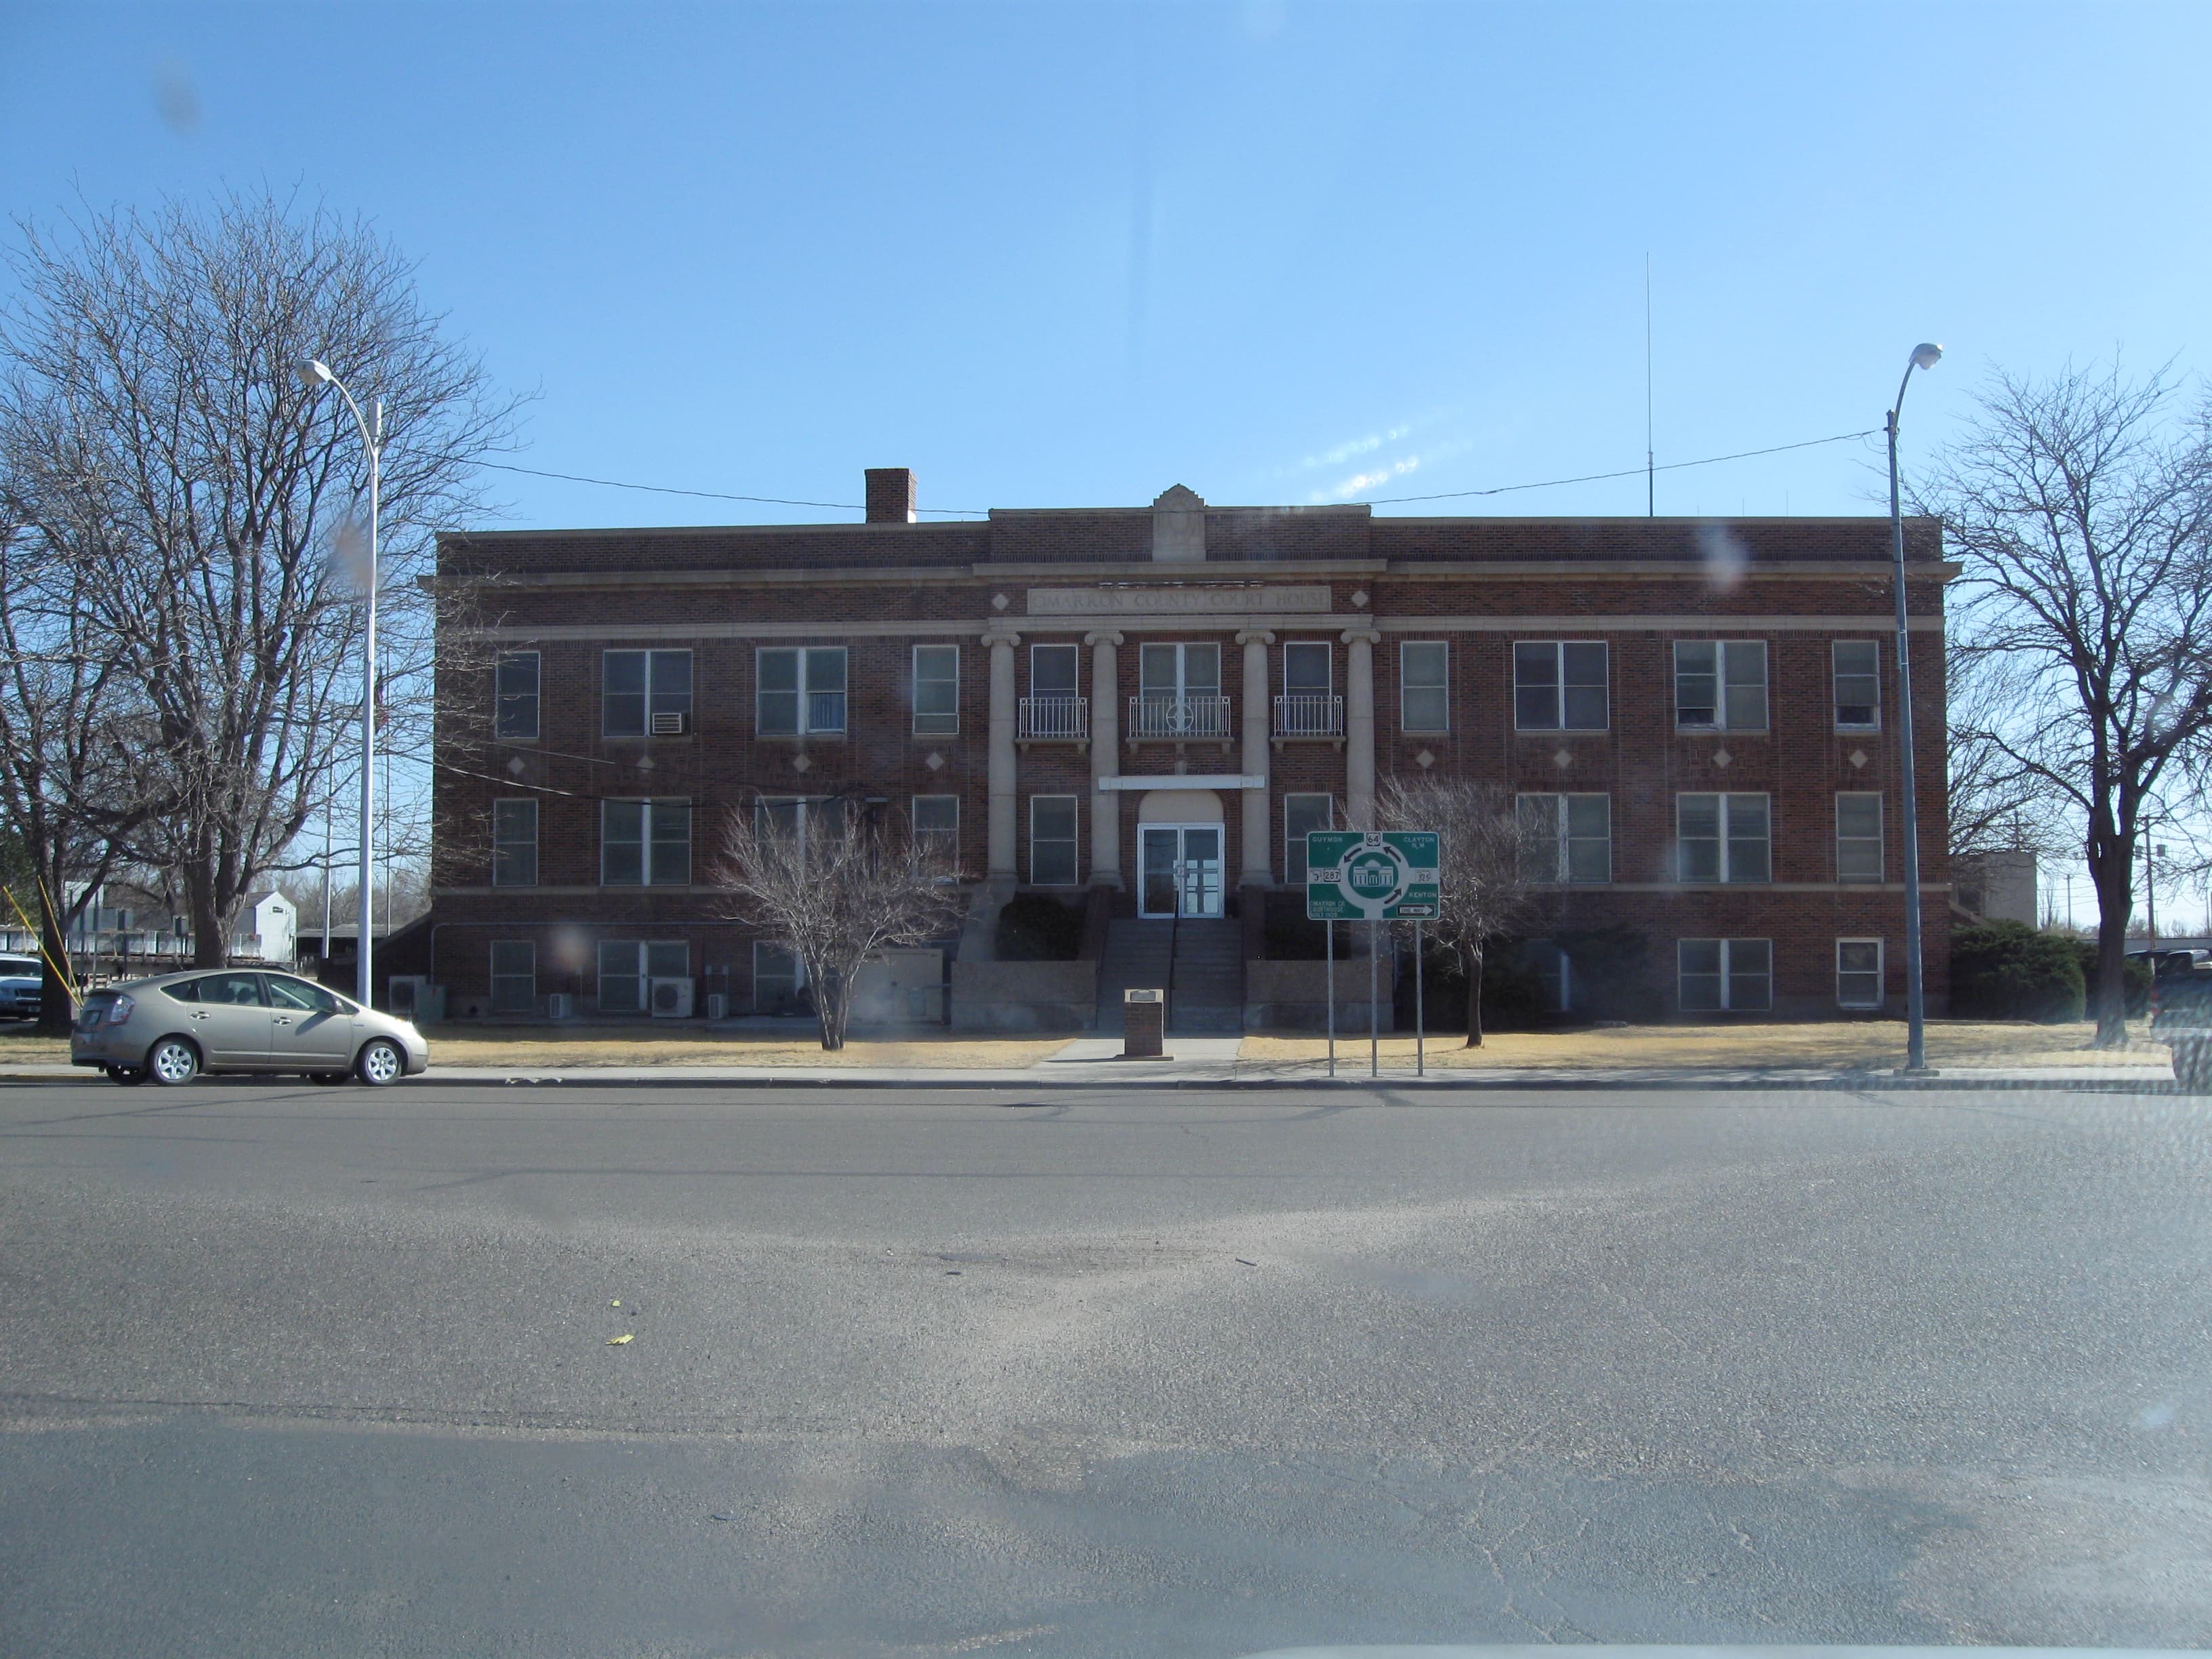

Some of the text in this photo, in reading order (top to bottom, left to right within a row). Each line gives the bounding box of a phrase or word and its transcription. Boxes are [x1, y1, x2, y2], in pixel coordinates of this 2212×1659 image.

[1031, 592, 1328, 609] CIMARRON COUNTY COURT HOUSE
[1368, 834, 1378, 843] 64
[1313, 872, 1319, 881] 3
[1324, 872, 1340, 880] 287
